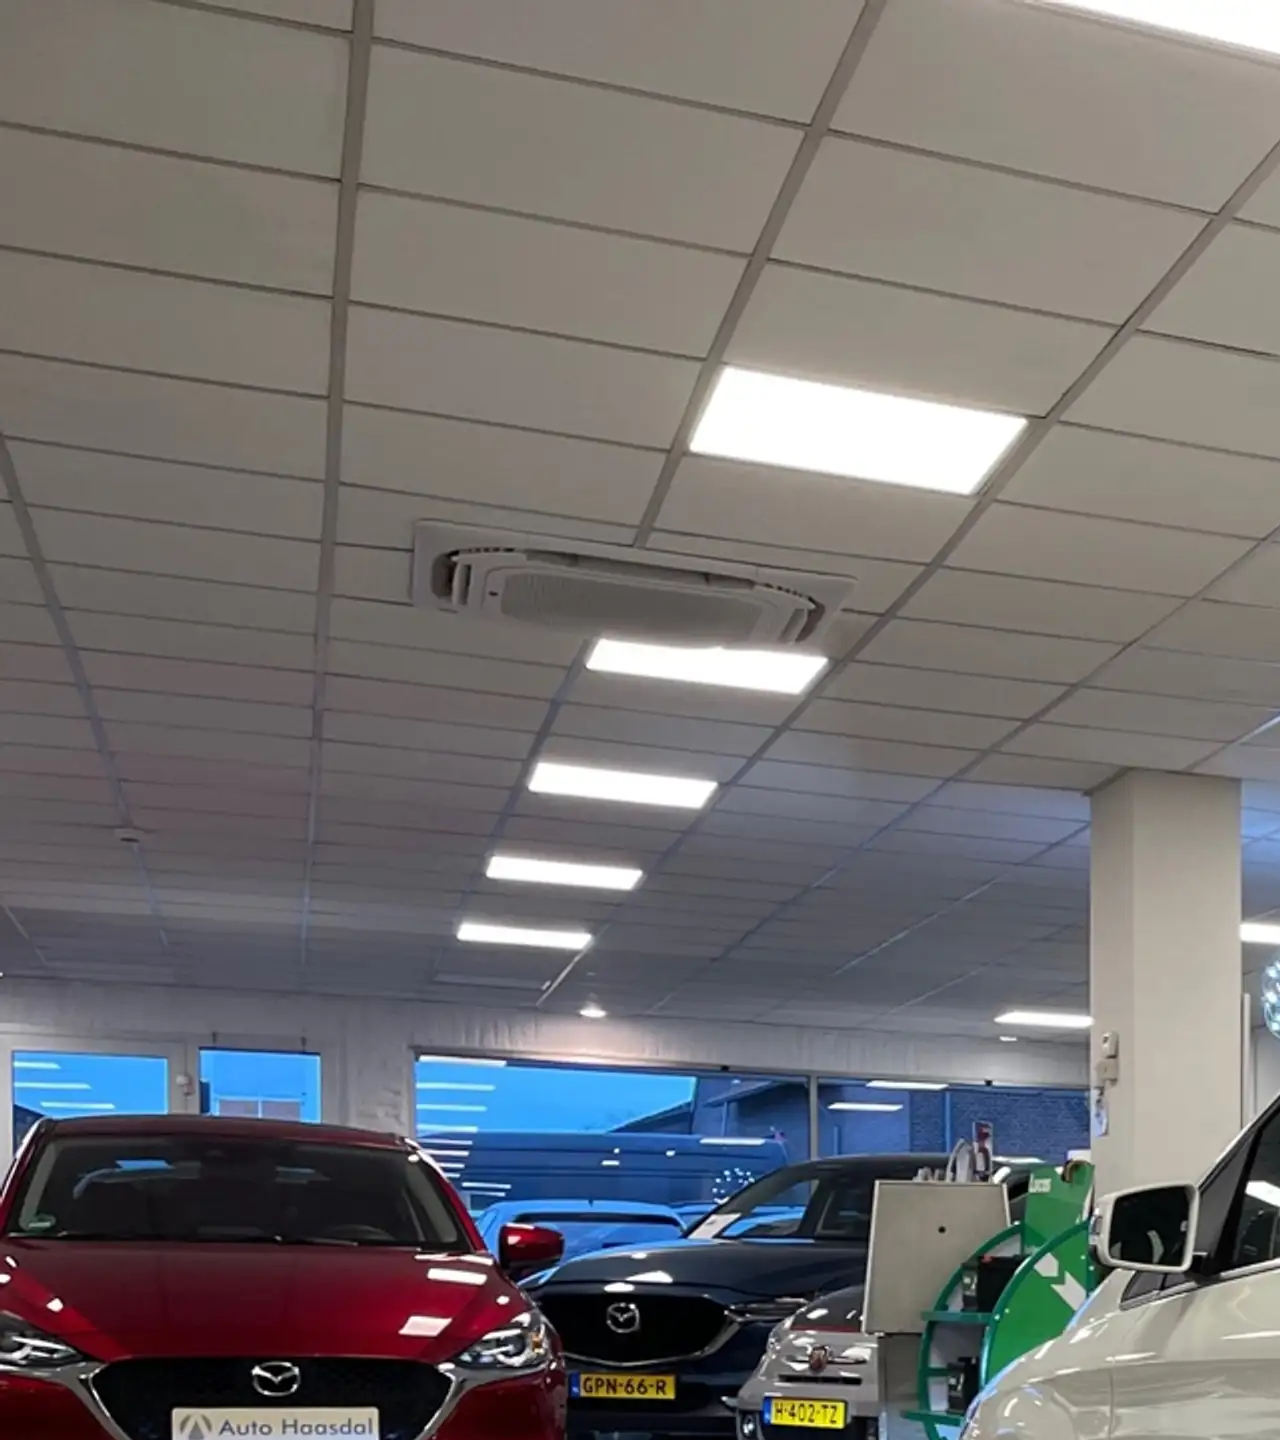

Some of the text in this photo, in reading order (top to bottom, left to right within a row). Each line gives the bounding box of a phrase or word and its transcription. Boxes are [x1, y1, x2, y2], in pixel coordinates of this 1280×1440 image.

[583, 1377, 668, 1395] GPN-66-R
[774, 1402, 838, 1424] H-402-TZ
[219, 1418, 373, 1436] Auto Haasdal
